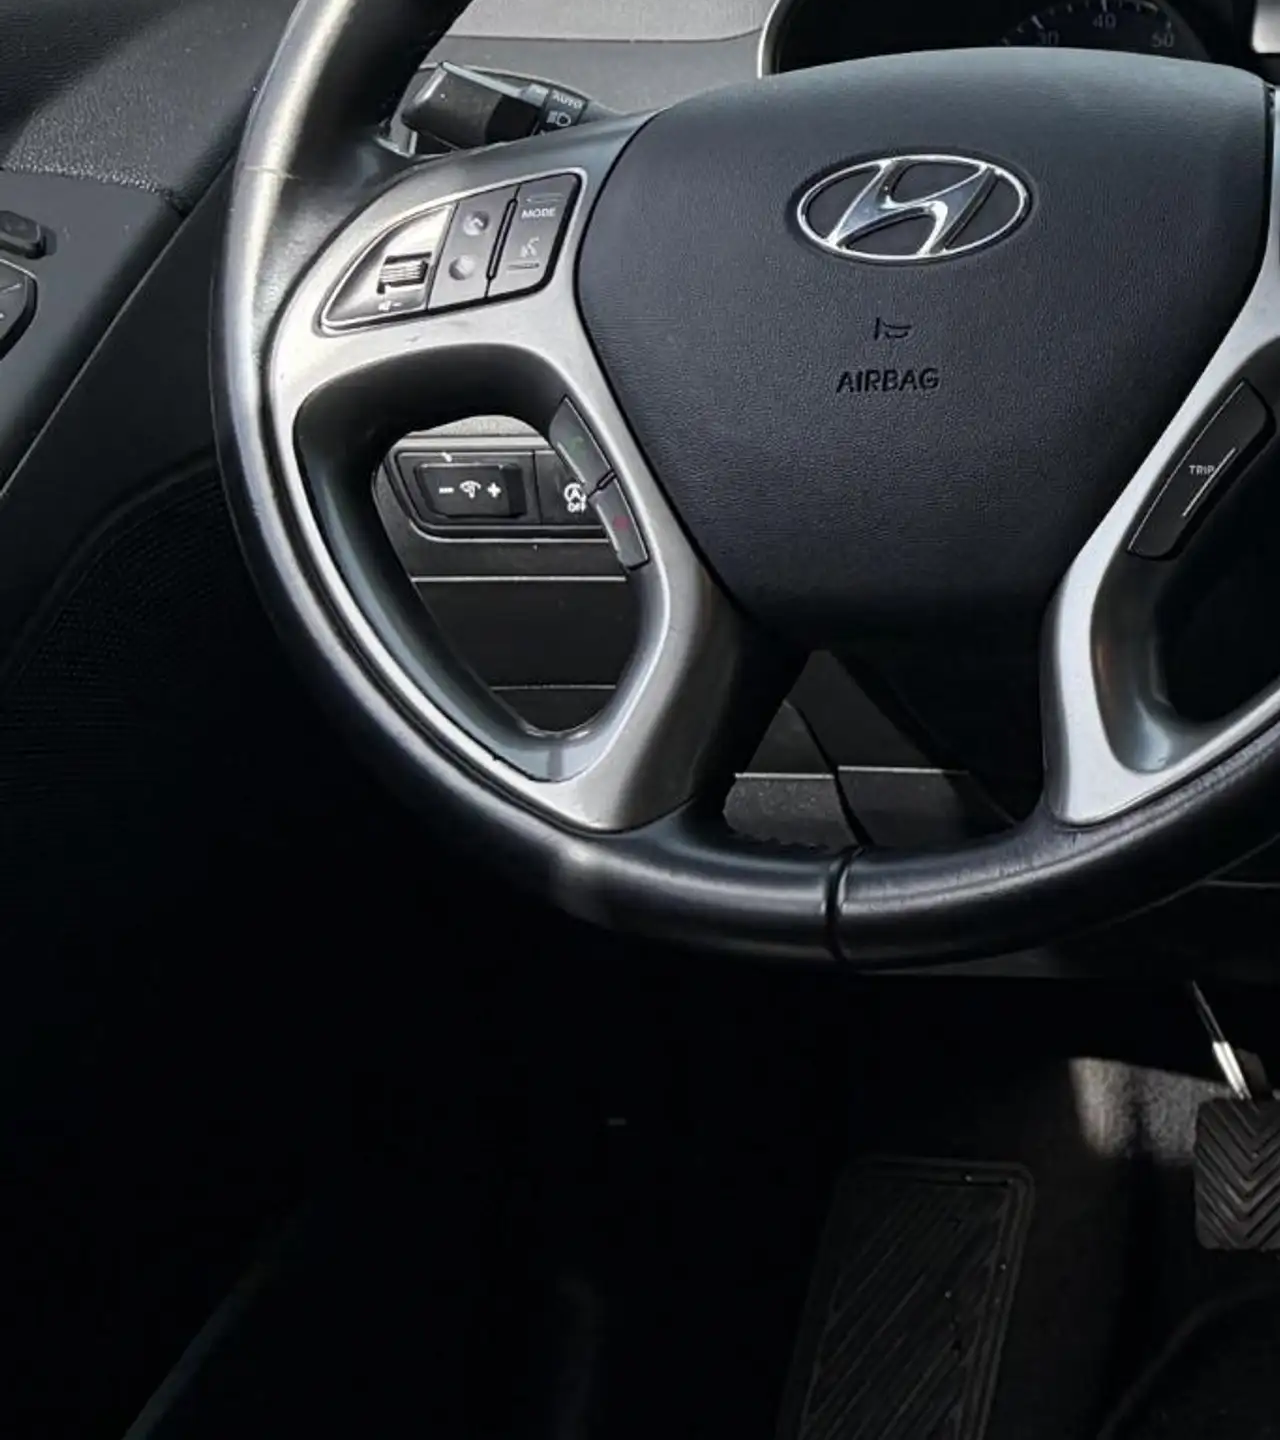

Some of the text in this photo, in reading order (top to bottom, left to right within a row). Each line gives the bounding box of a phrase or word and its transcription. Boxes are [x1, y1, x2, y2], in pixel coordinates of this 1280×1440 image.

[1151, 32, 1175, 48] 50
[551, 90, 583, 109] AUTO
[521, 207, 556, 219] MODE
[836, 368, 940, 393] AIRBAG
[1188, 464, 1215, 476] TRIP
